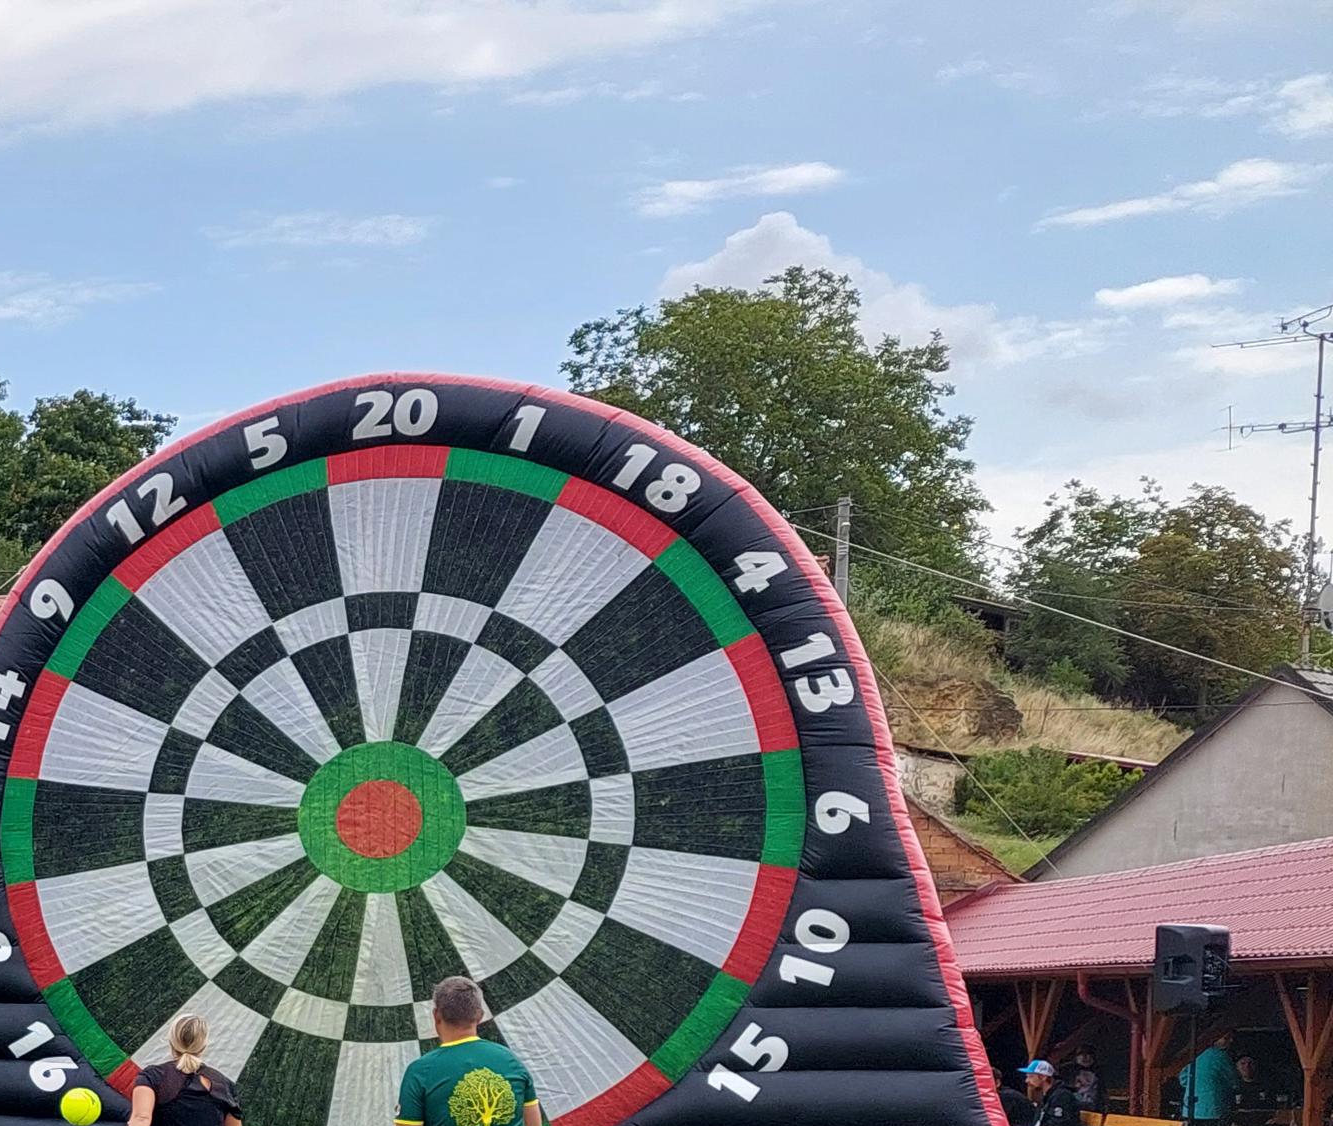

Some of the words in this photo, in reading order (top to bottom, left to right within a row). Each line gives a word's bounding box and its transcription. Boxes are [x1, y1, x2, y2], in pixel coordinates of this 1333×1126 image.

[243, 415, 288, 470] 5
[352, 388, 439, 440] 20
[509, 404, 547, 452] 1
[105, 472, 188, 545] 12
[612, 443, 702, 513] 18
[29, 577, 75, 623] 9
[733, 551, 790, 593] 4
[779, 631, 855, 713] 13
[778, 908, 850, 987] 10
[8, 1020, 80, 1093] 16
[704, 1021, 789, 1103] 15
